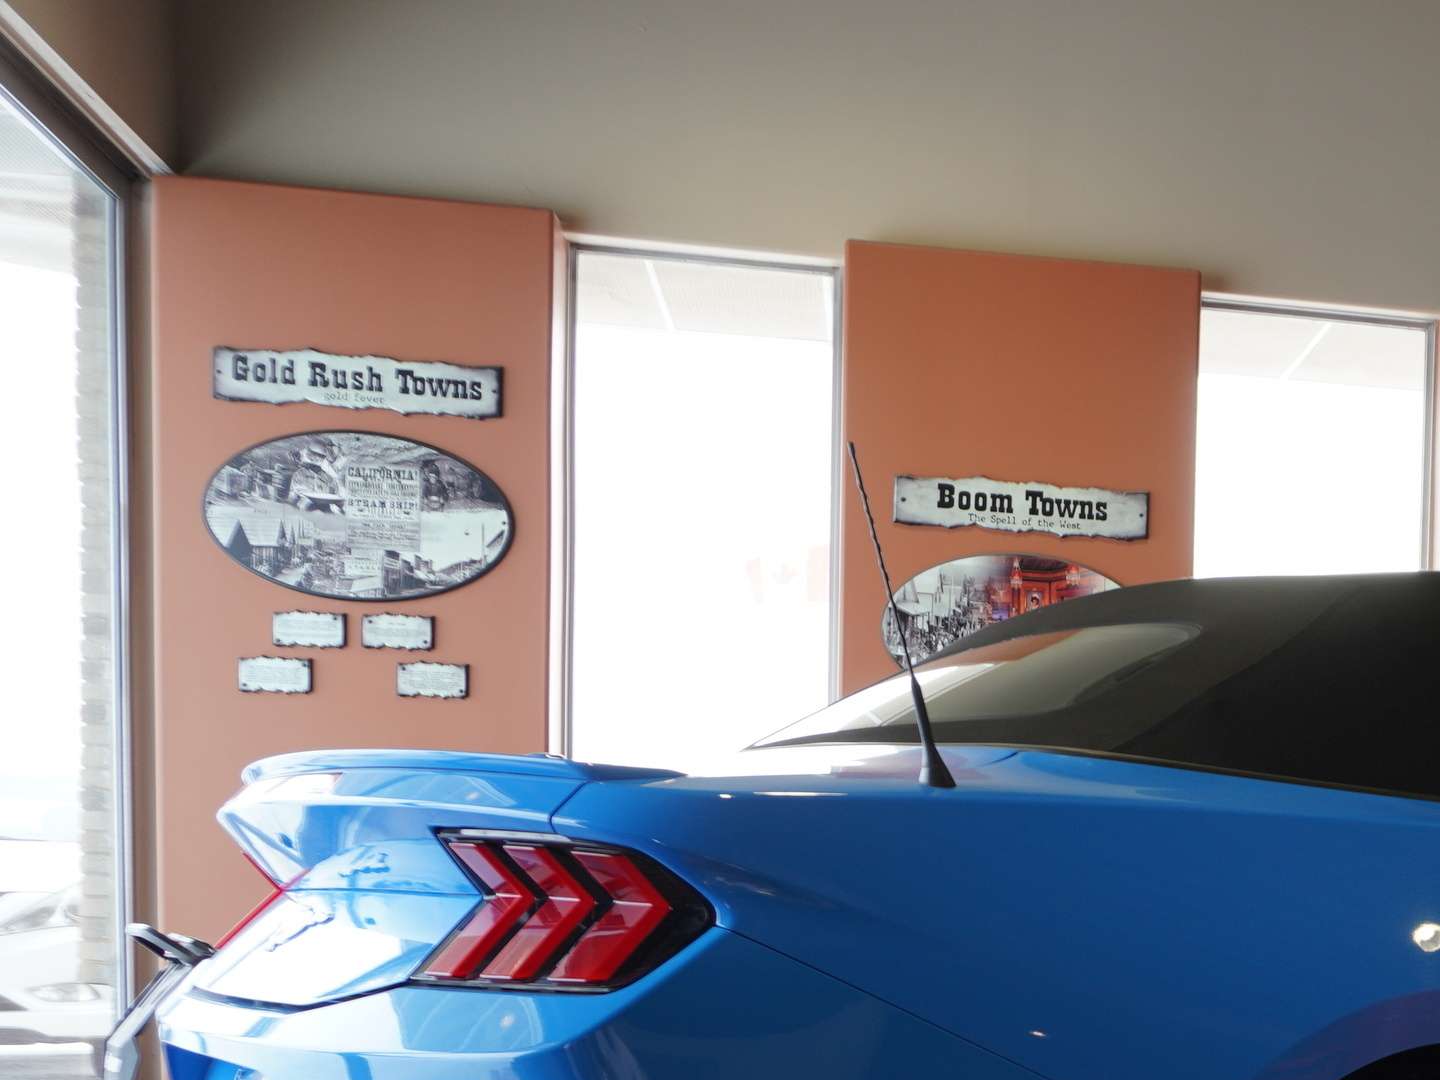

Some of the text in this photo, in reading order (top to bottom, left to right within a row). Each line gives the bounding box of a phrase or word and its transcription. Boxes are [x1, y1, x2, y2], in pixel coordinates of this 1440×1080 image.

[231, 354, 483, 401] Gold Rush Towns
[937, 483, 1108, 521] Boom Towns
[968, 512, 1081, 530] The Spell of the West
